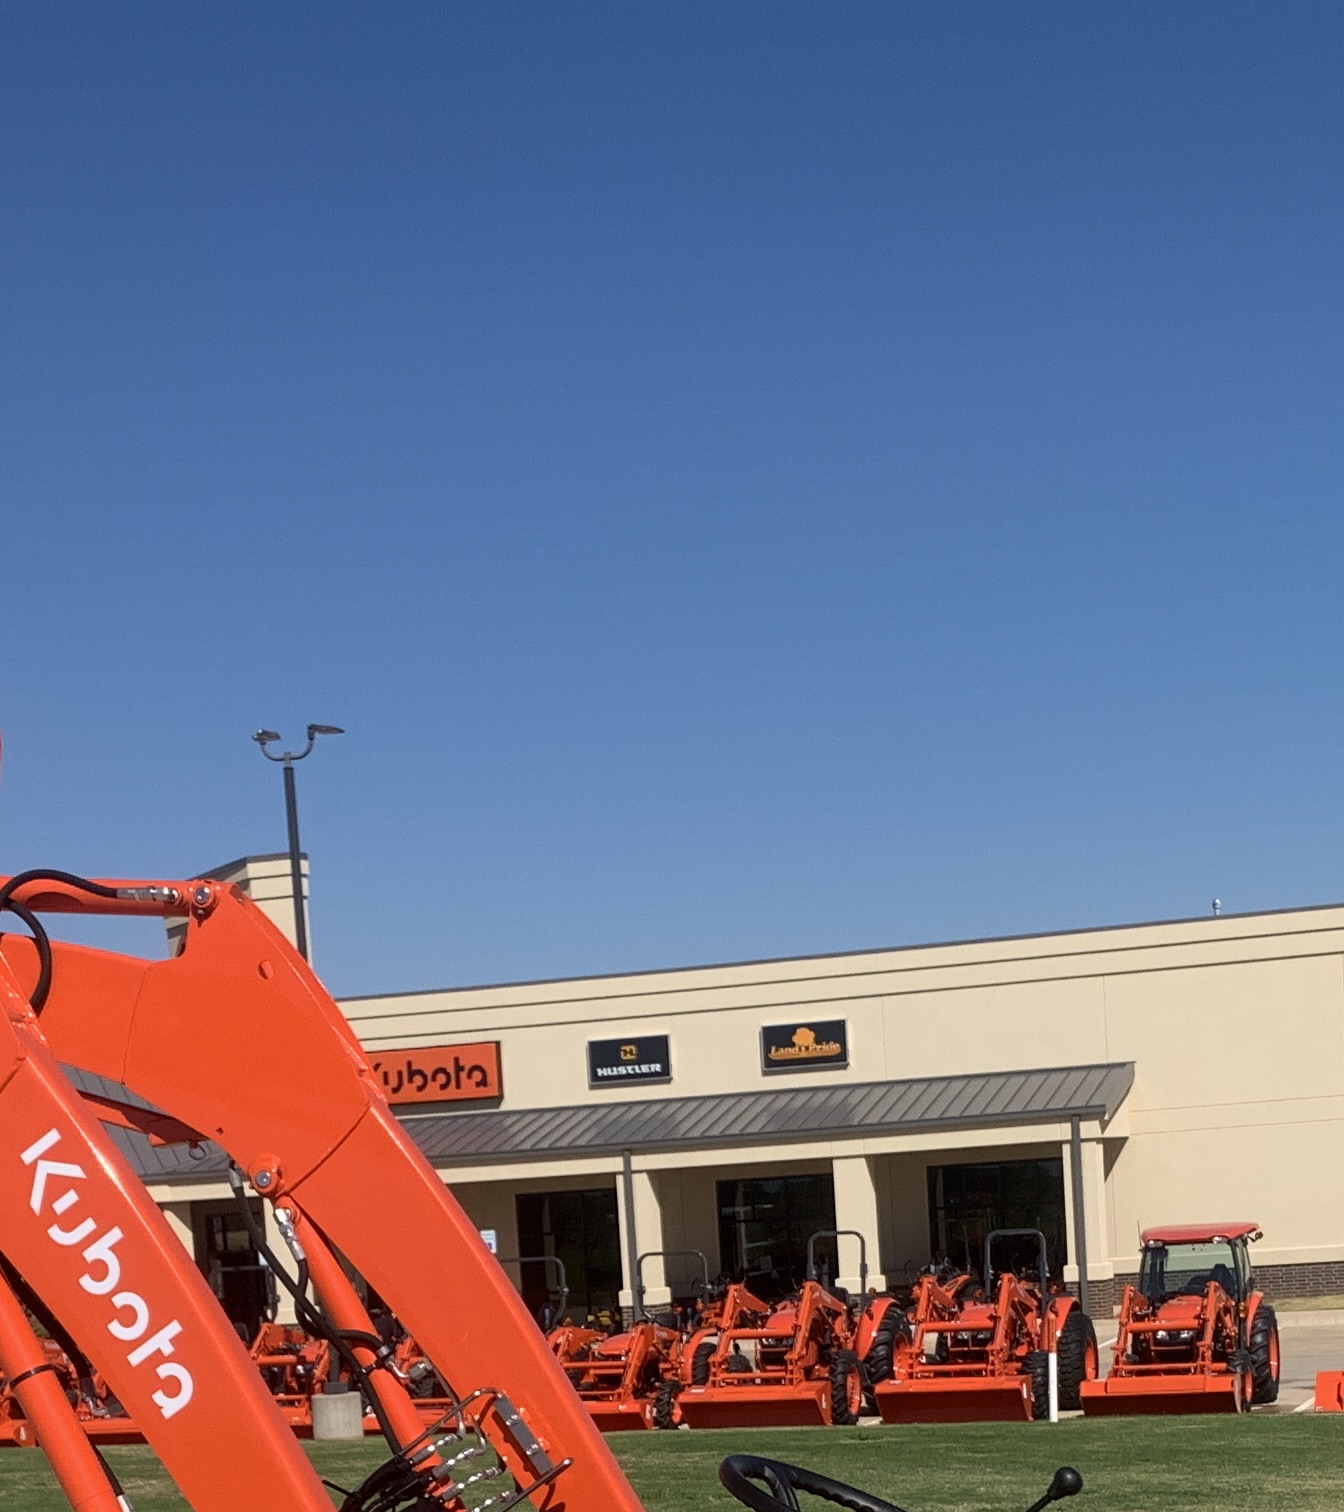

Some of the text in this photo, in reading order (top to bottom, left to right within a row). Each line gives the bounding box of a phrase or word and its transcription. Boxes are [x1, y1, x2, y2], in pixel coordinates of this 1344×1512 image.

[373, 1056, 488, 1094] ubota
[596, 1063, 662, 1077] HUSTLER
[20, 1126, 195, 1421] Kubota
